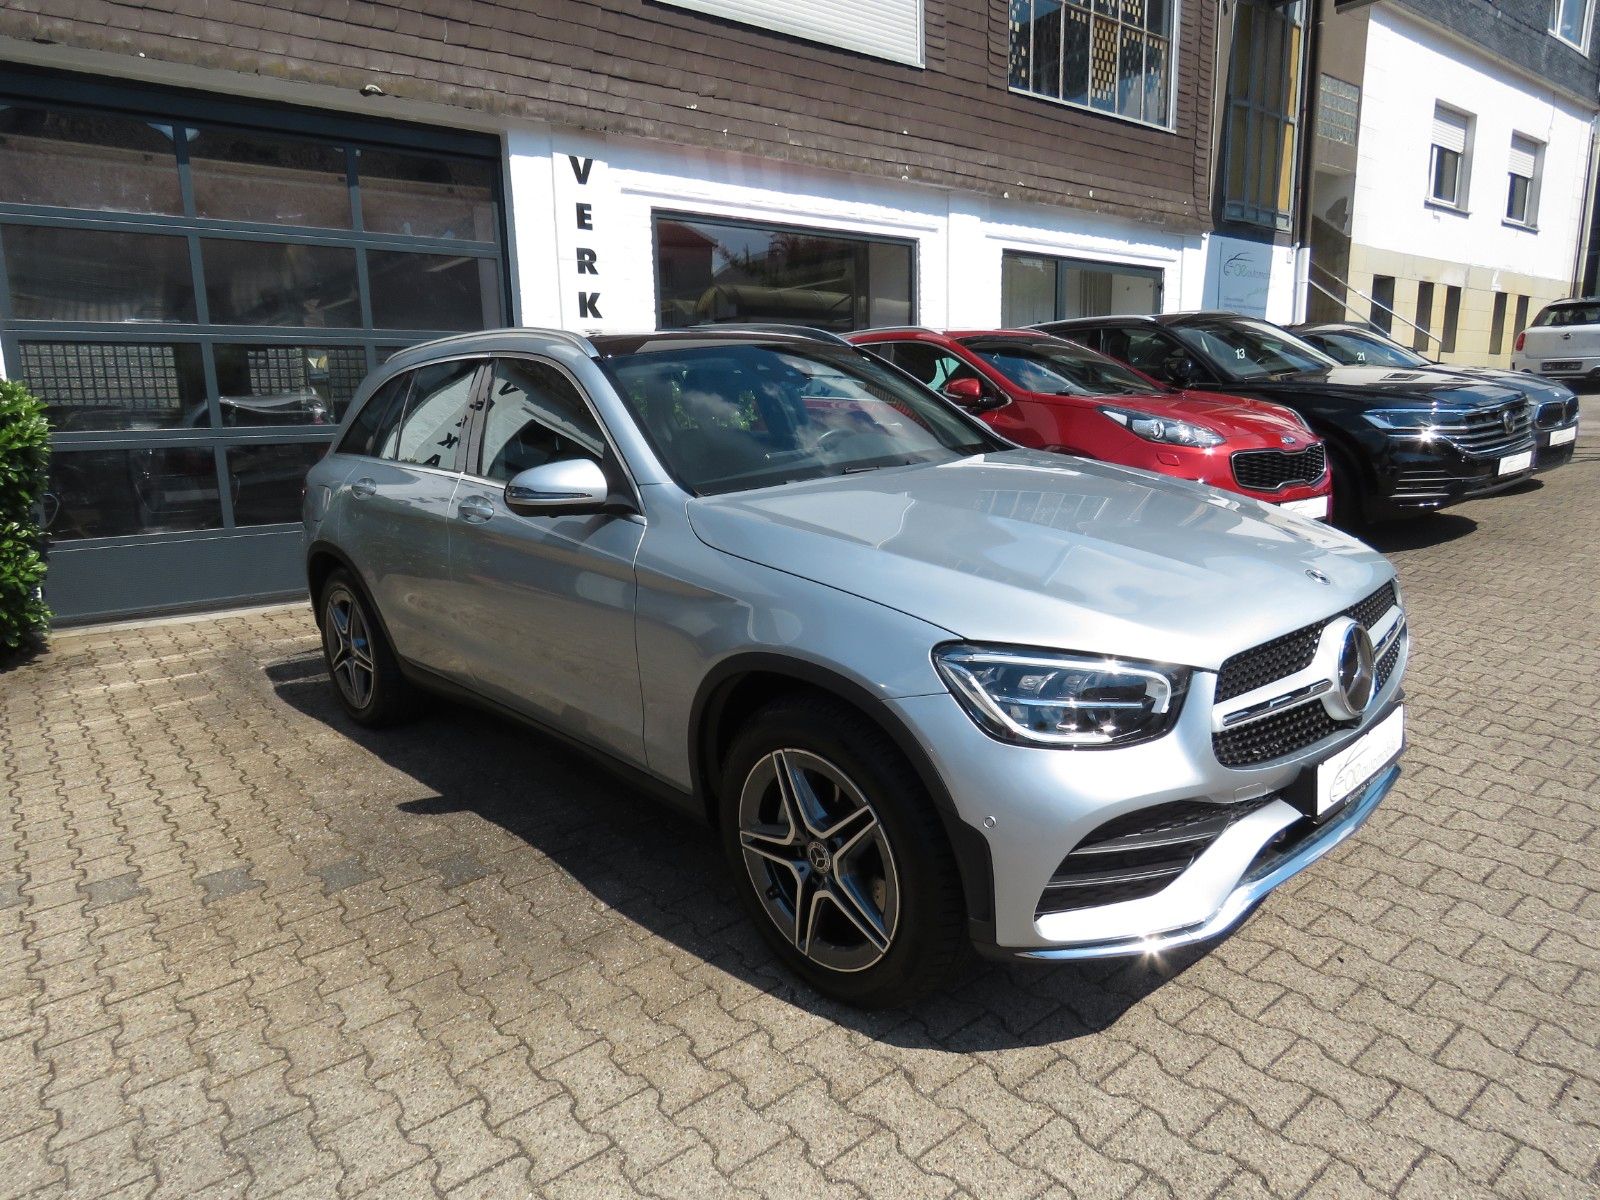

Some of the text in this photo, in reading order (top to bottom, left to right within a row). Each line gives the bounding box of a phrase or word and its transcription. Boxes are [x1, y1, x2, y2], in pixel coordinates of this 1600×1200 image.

[568, 155, 603, 319] VERK
[1235, 348, 1246, 359] 13
[1356, 352, 1366, 361] 21
